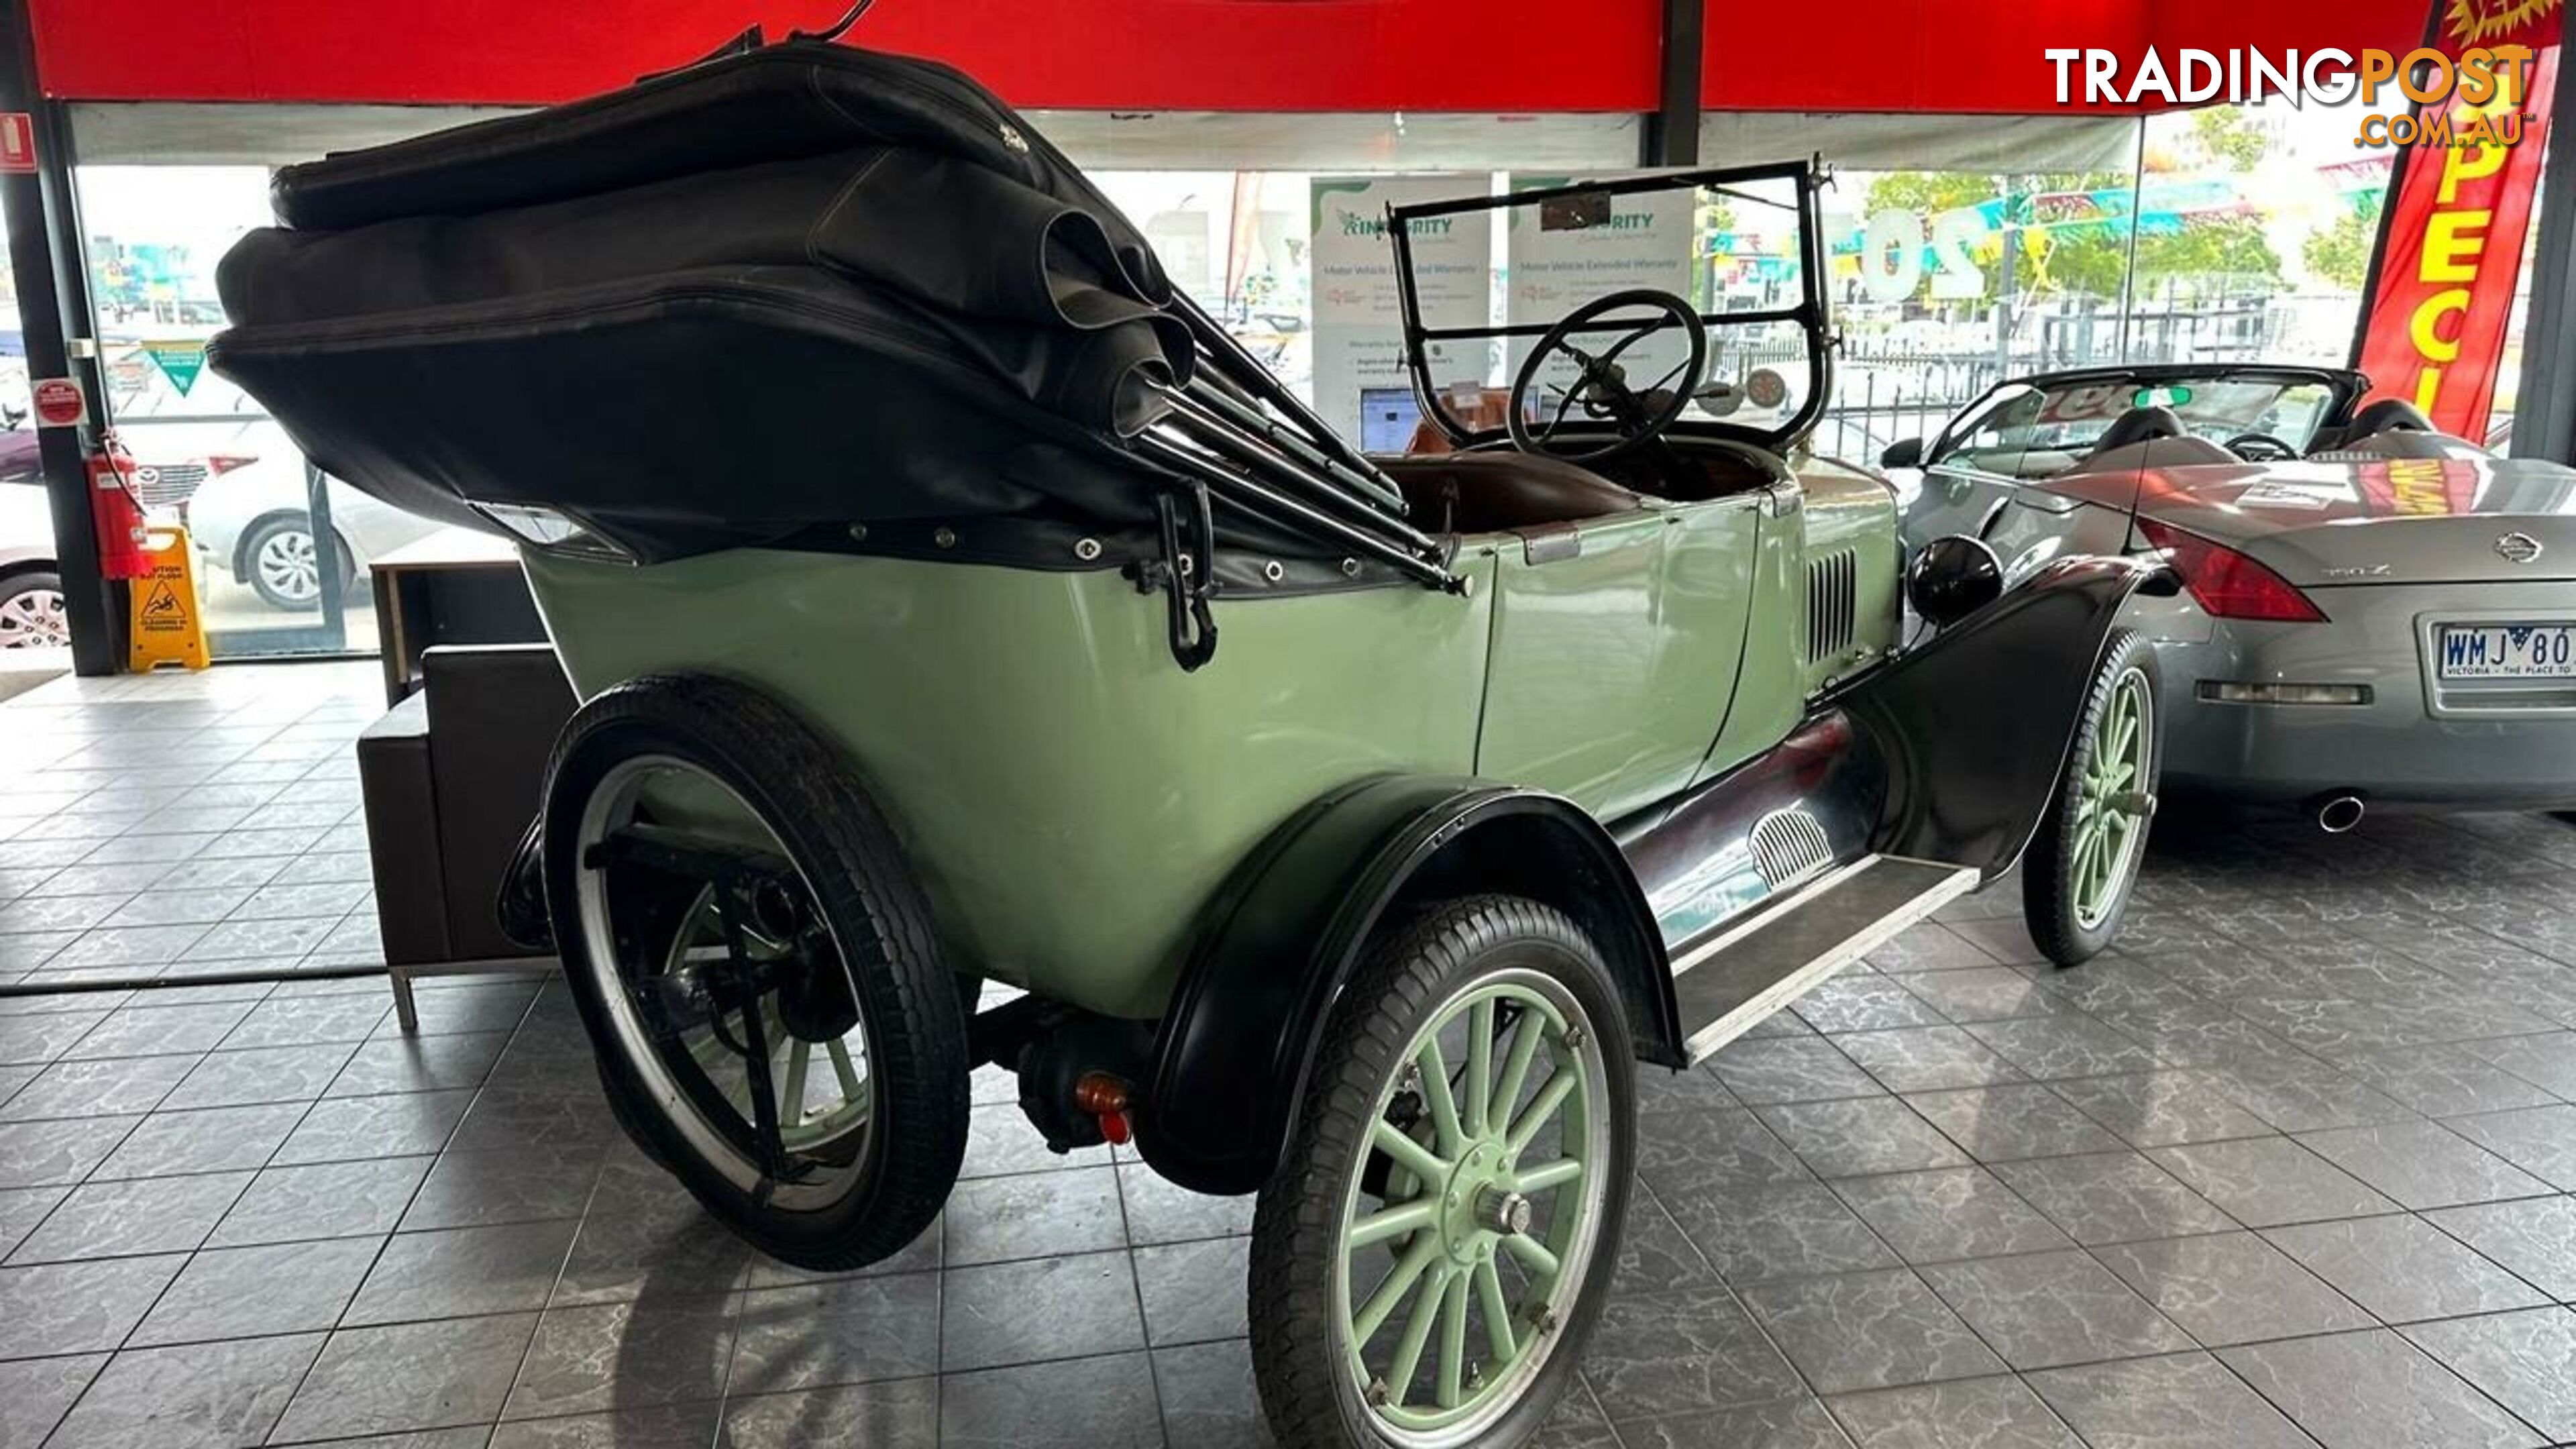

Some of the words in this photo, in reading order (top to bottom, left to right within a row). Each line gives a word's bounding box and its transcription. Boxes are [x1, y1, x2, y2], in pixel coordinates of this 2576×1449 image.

[2448, 633, 2506, 665] WMJ
[2447, 666, 2490, 675] VICTORIA
[2505, 666, 2521, 674] THE
[2525, 666, 2553, 674] PLACE
[2559, 666, 2571, 674] TO
